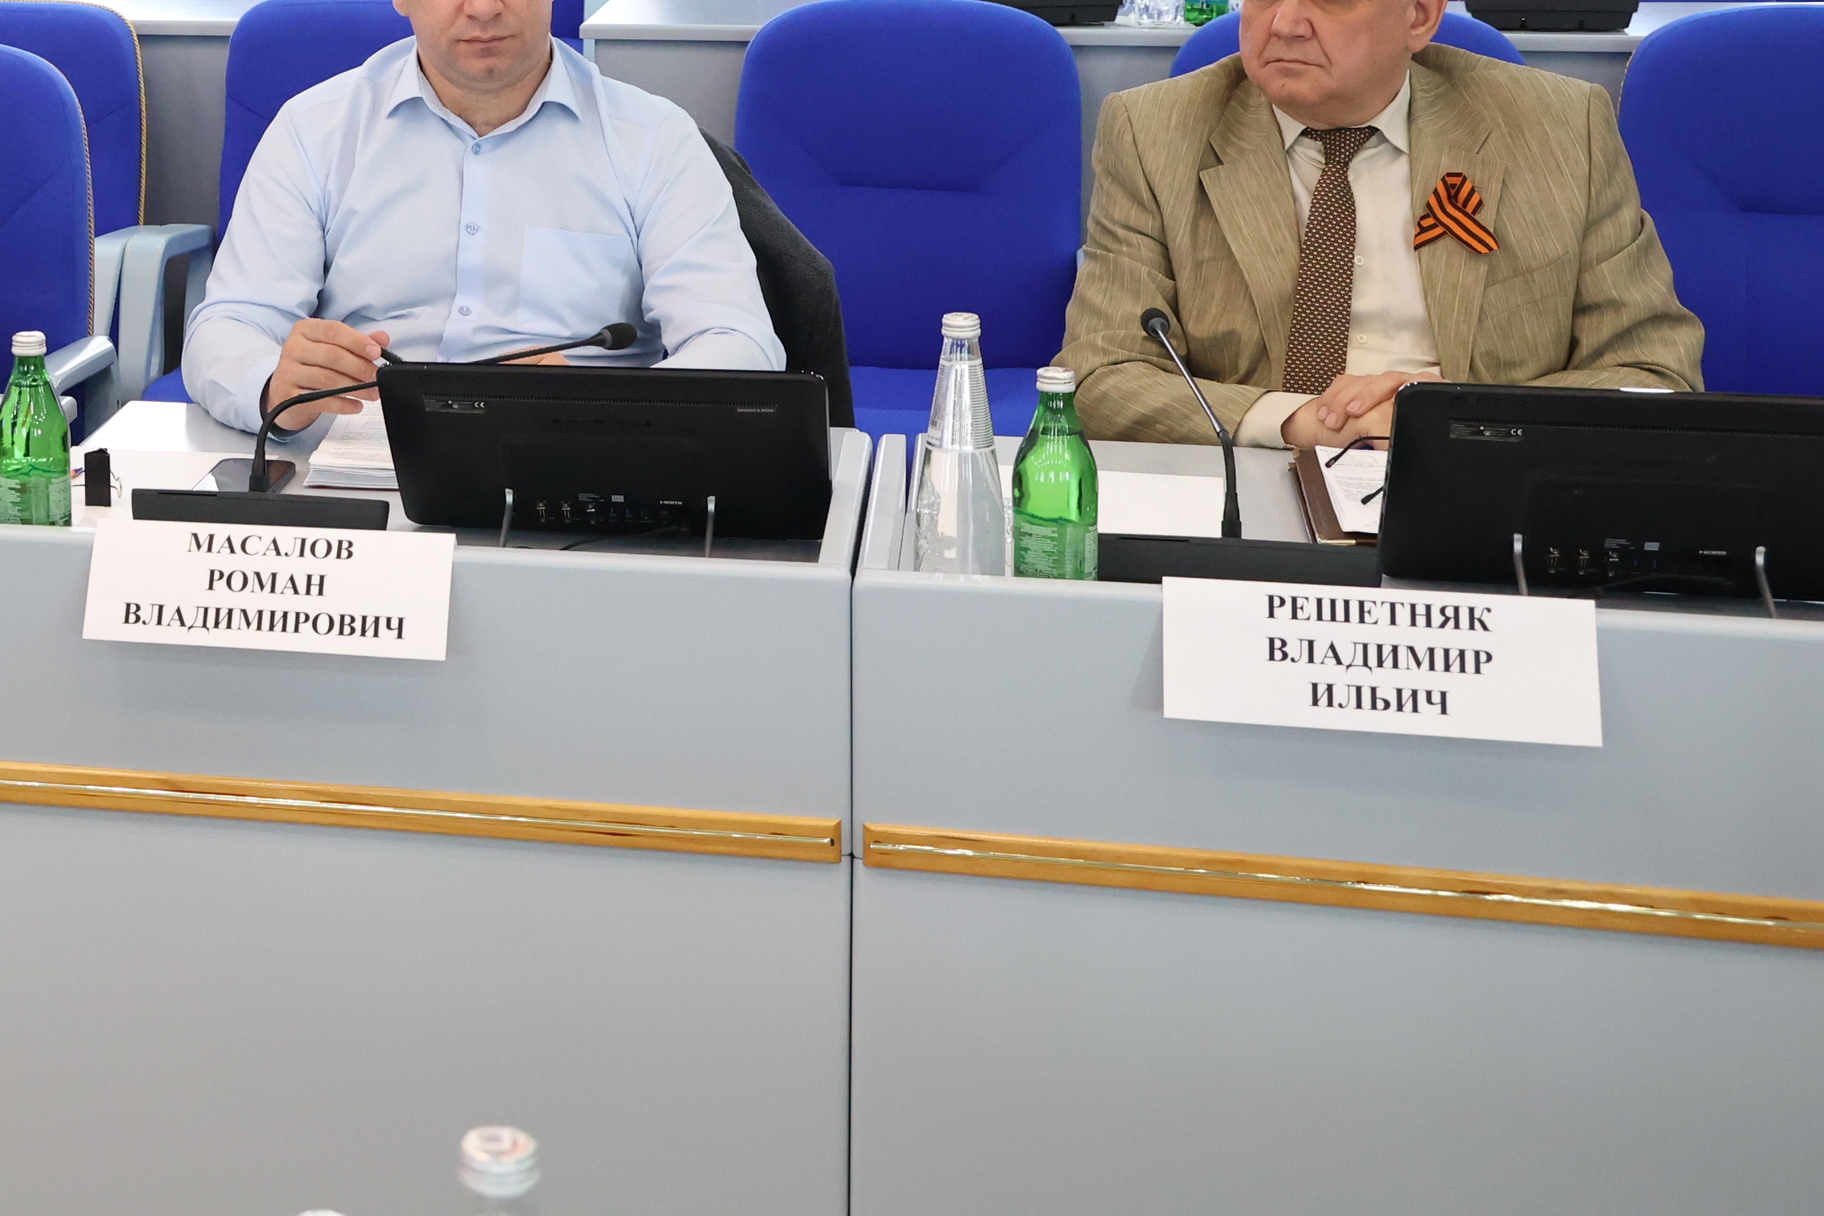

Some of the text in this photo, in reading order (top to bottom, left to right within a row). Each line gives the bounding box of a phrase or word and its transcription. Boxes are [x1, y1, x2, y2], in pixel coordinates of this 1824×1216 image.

[186, 532, 354, 560] МАСАЛОВ
[206, 568, 326, 597] РОМАН
[122, 602, 406, 640] ВЛАДИМИРОВИЧ
[1266, 594, 1492, 632] РЕШЕТНЯК
[1266, 636, 1493, 675] ВЛАДИМИР
[1308, 682, 1450, 716] ИЛЬИЧ
